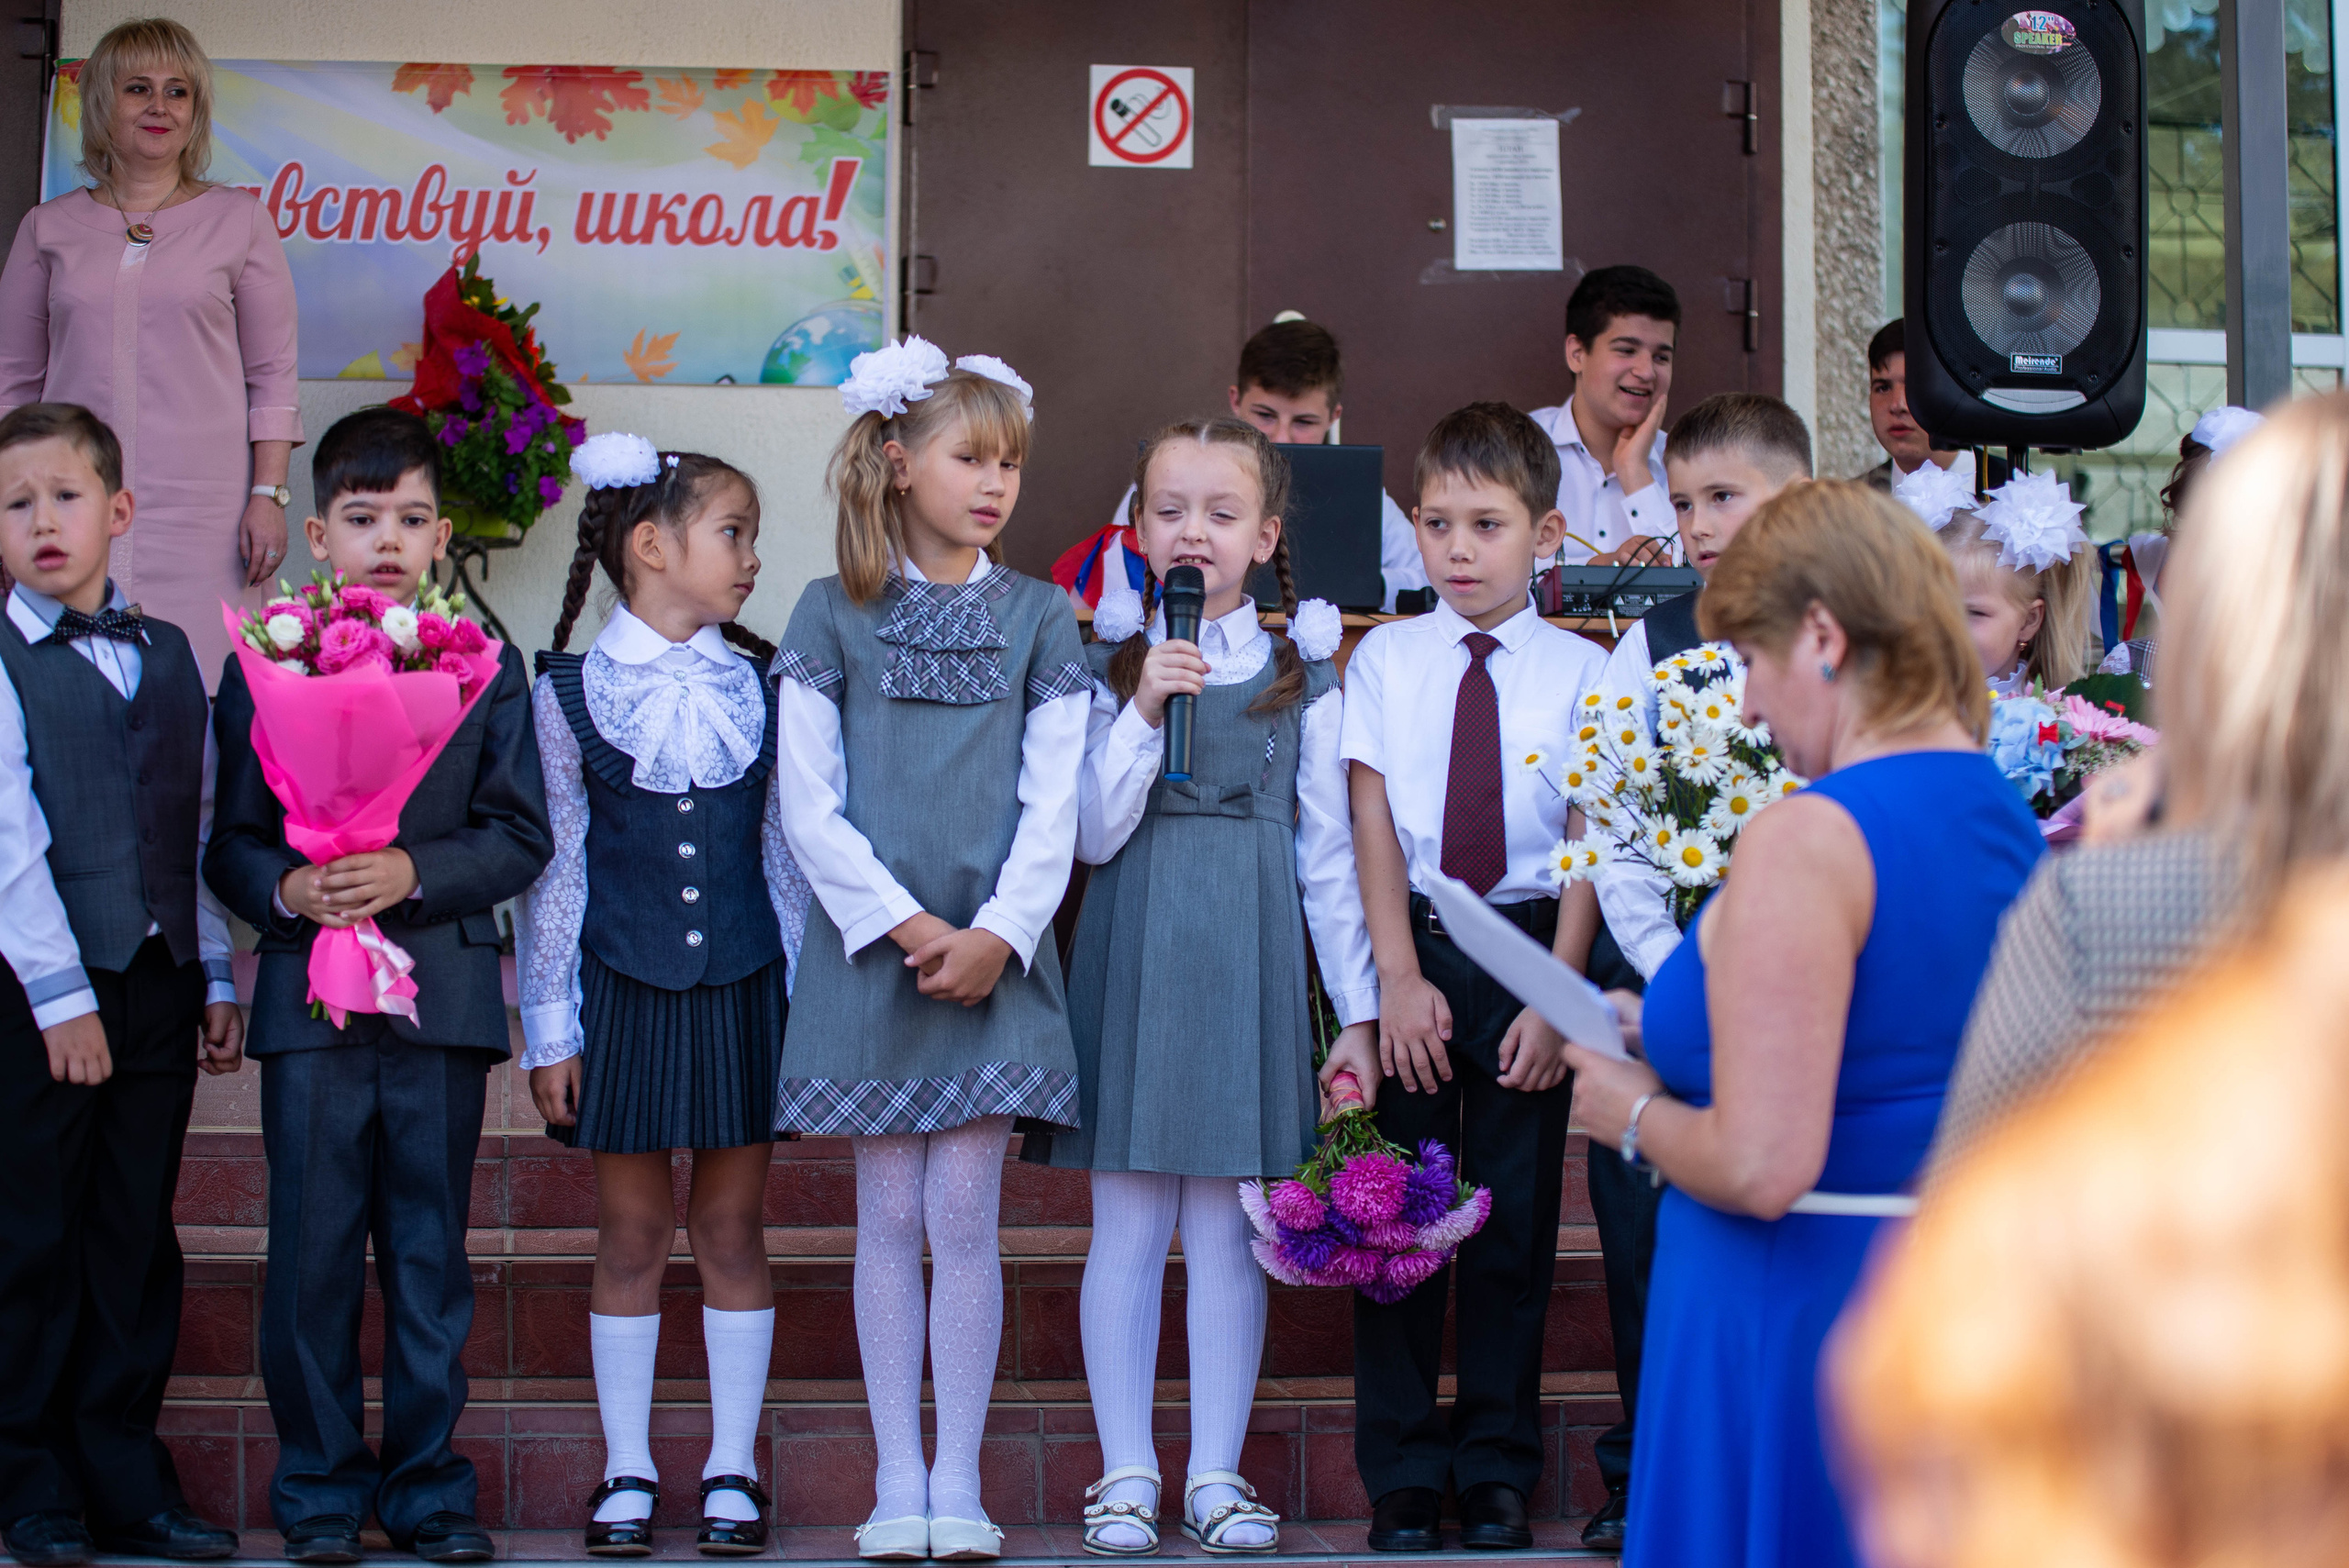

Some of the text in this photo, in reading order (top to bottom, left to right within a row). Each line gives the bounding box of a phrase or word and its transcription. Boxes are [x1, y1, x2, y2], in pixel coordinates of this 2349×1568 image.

[2031, 16, 2054, 31] 12"
[2013, 31, 2063, 45] SPEAKER
[573, 160, 861, 250] школа!
